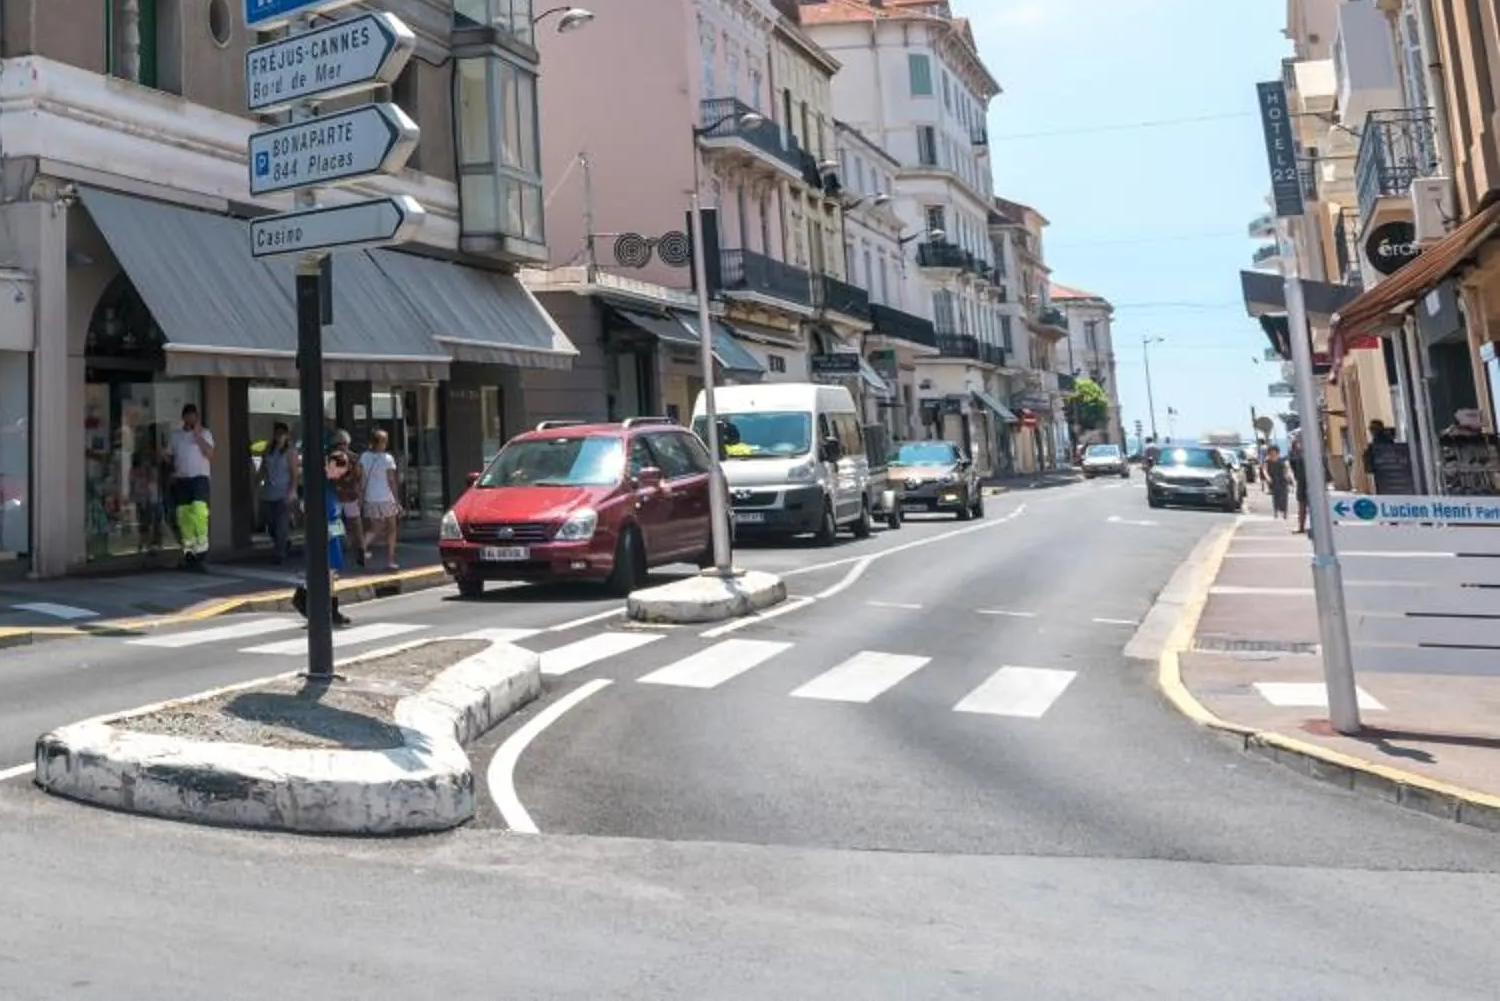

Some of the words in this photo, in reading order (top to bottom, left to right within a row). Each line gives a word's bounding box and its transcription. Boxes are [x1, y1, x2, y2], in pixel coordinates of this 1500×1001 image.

[253, 75, 283, 99] Bord
[291, 71, 307, 90] de
[315, 62, 342, 83] Mer
[272, 122, 353, 159] BONAPARTE
[1267, 93, 1287, 165] HOTEL
[272, 158, 298, 182] 844
[307, 152, 354, 174] Places
[1273, 166, 1297, 182] 22
[257, 227, 303, 248] Casino
[1381, 502, 1429, 518] Lucien
[1432, 501, 1473, 519] Henri
